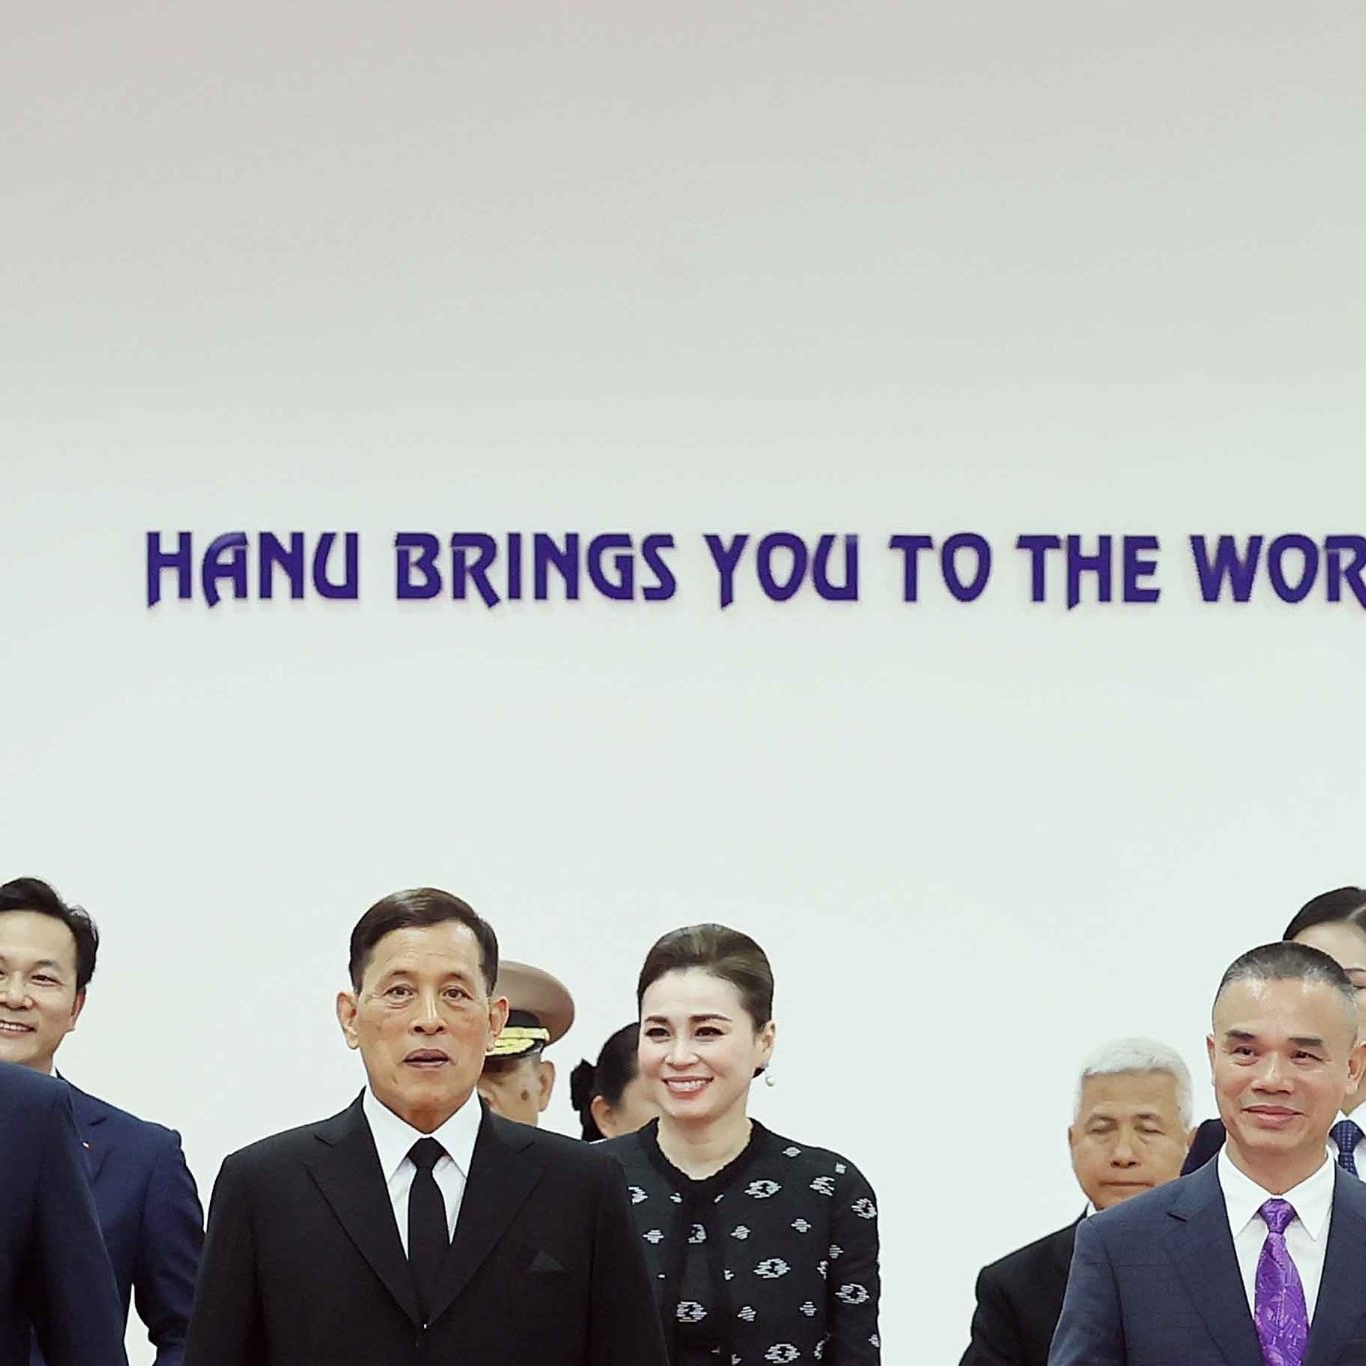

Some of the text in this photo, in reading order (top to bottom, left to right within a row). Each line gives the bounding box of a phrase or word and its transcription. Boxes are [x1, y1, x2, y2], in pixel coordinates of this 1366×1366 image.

[146, 531, 360, 608] HANU
[394, 531, 678, 608] BRINGS
[704, 532, 860, 608] YOU
[889, 532, 993, 603] TO
[1016, 533, 1161, 609] THE
